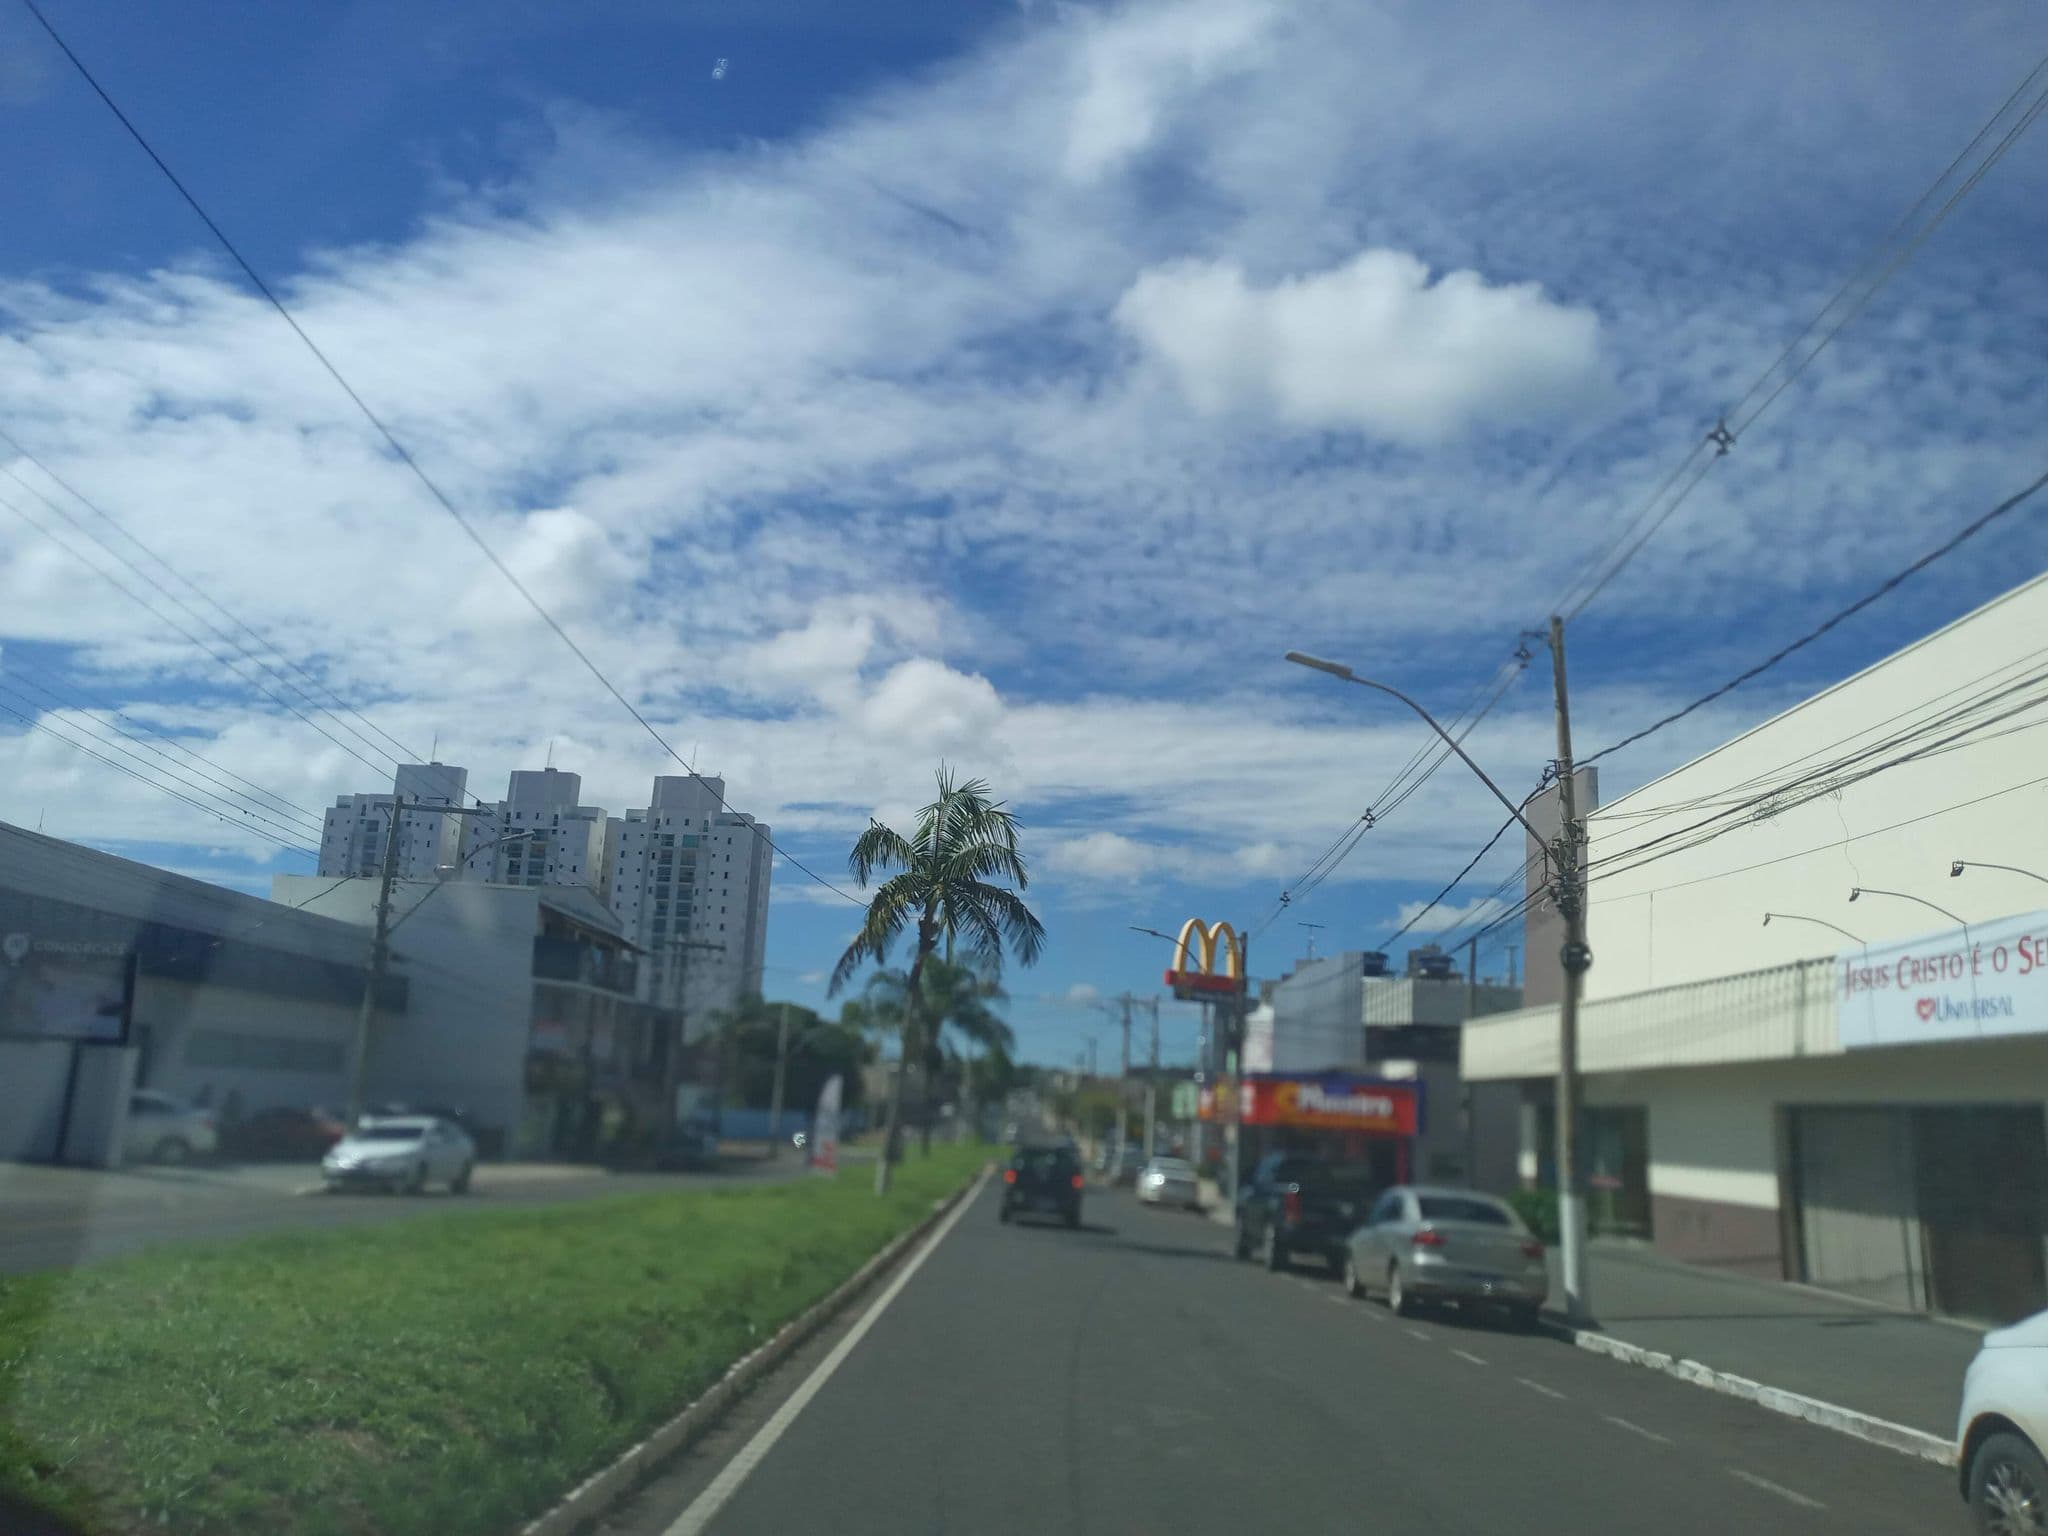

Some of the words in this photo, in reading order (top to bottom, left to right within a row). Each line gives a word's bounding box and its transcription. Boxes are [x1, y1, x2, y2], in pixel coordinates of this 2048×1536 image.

[1845, 959, 1889, 997] JESUS
[1897, 952, 1964, 990] CRISTO
[1972, 941, 1982, 976] É
[1992, 946, 2008, 972] O
[2018, 935, 2048, 975] SE
[1935, 995, 2015, 1021] UNIVERSAL
